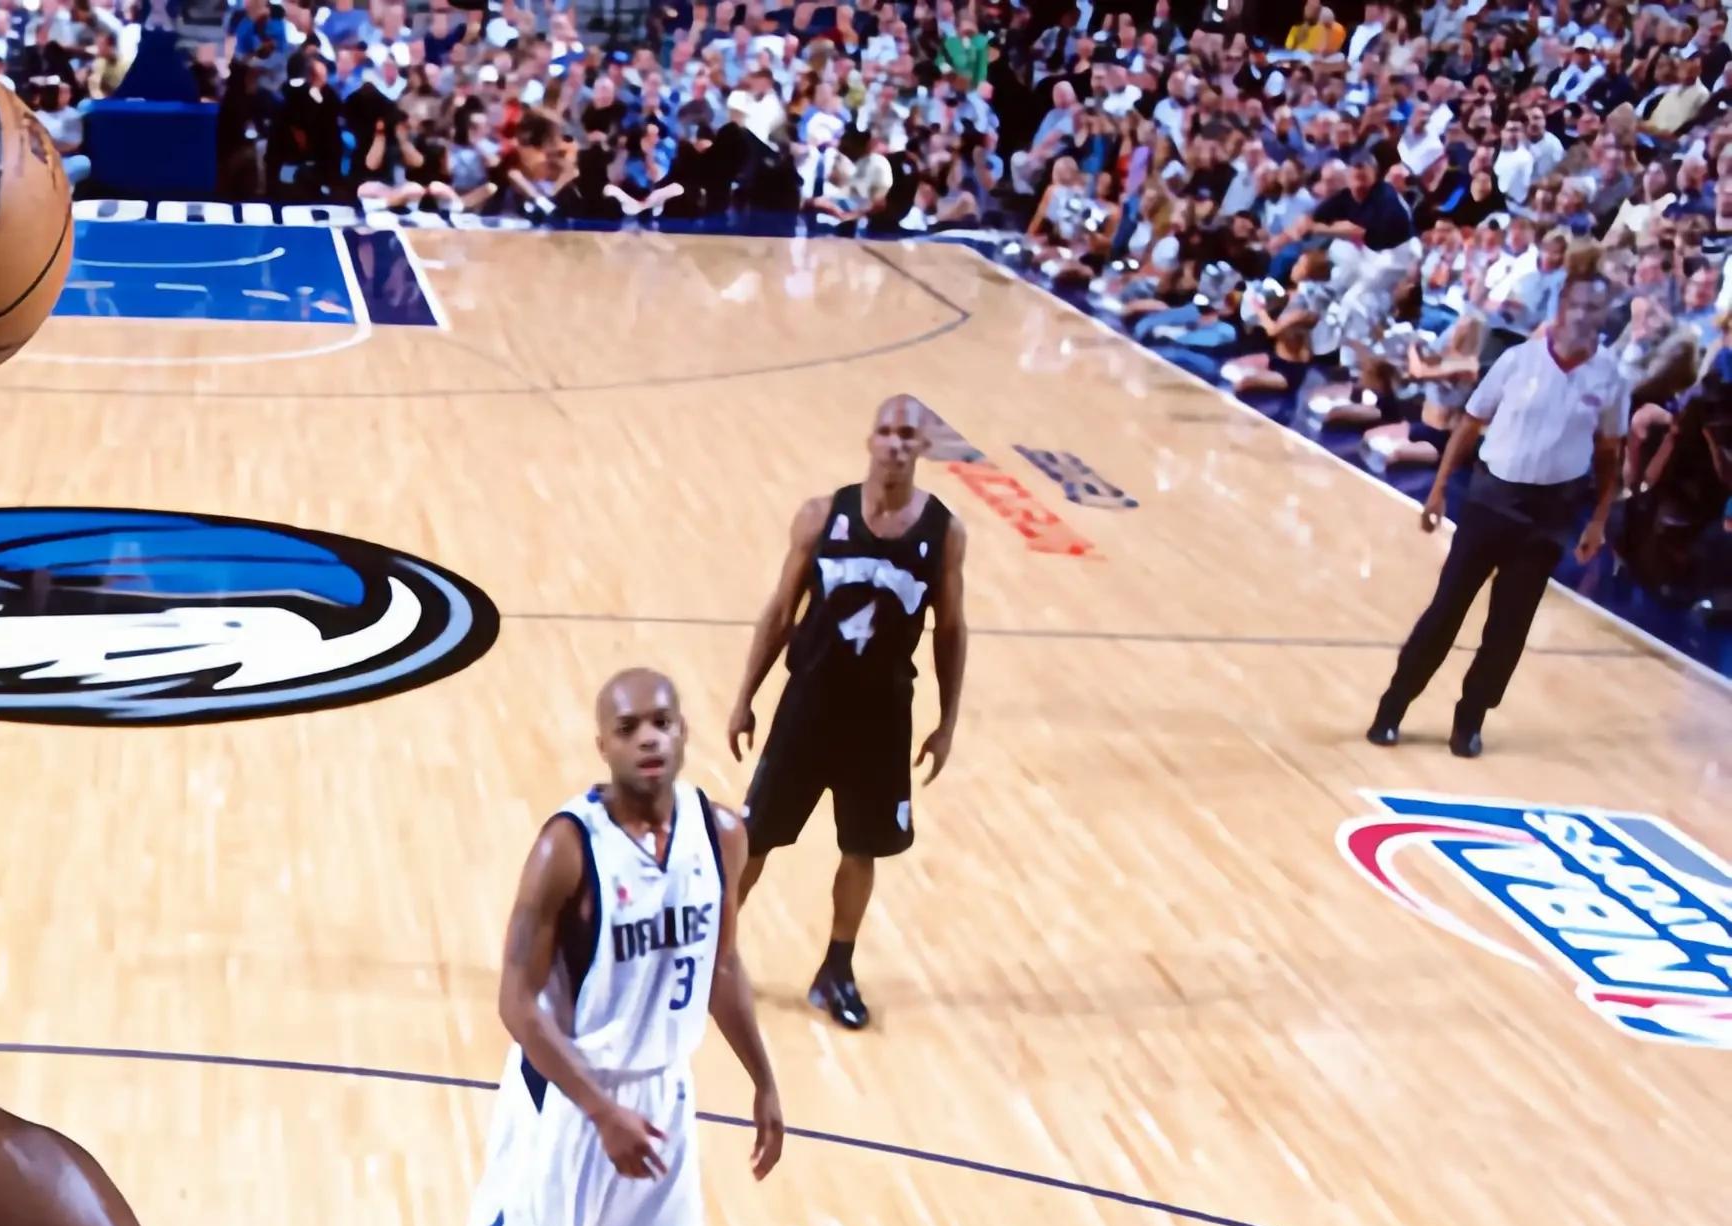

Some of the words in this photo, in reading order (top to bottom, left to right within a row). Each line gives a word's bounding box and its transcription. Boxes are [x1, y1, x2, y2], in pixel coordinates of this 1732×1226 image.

[838, 601, 877, 657] 4
[1459, 846, 1731, 993] NBA
[668, 955, 696, 1010] 3
